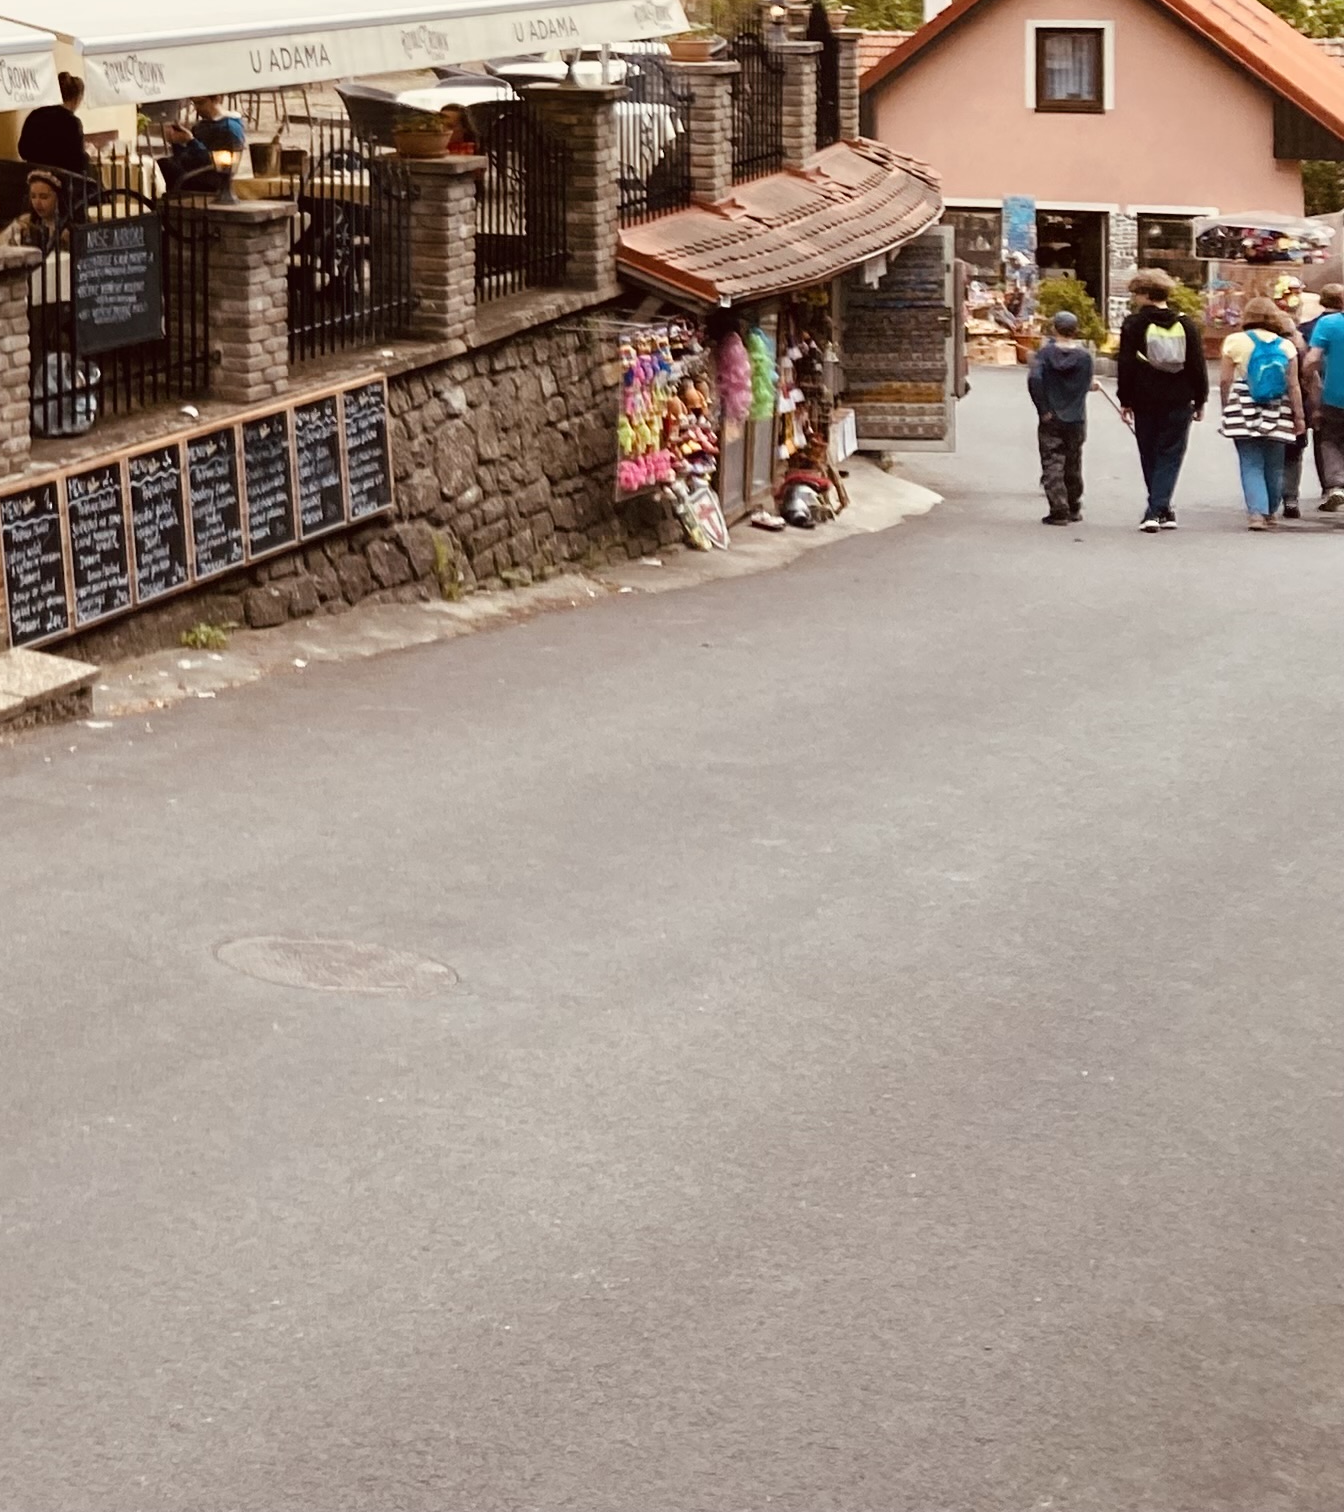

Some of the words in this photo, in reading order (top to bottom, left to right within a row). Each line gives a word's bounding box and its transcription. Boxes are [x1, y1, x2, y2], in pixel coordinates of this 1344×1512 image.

[512, 22, 525, 42] U
[529, 16, 580, 41] ADAMA
[249, 49, 262, 74] U
[269, 43, 332, 72] ADAMA
